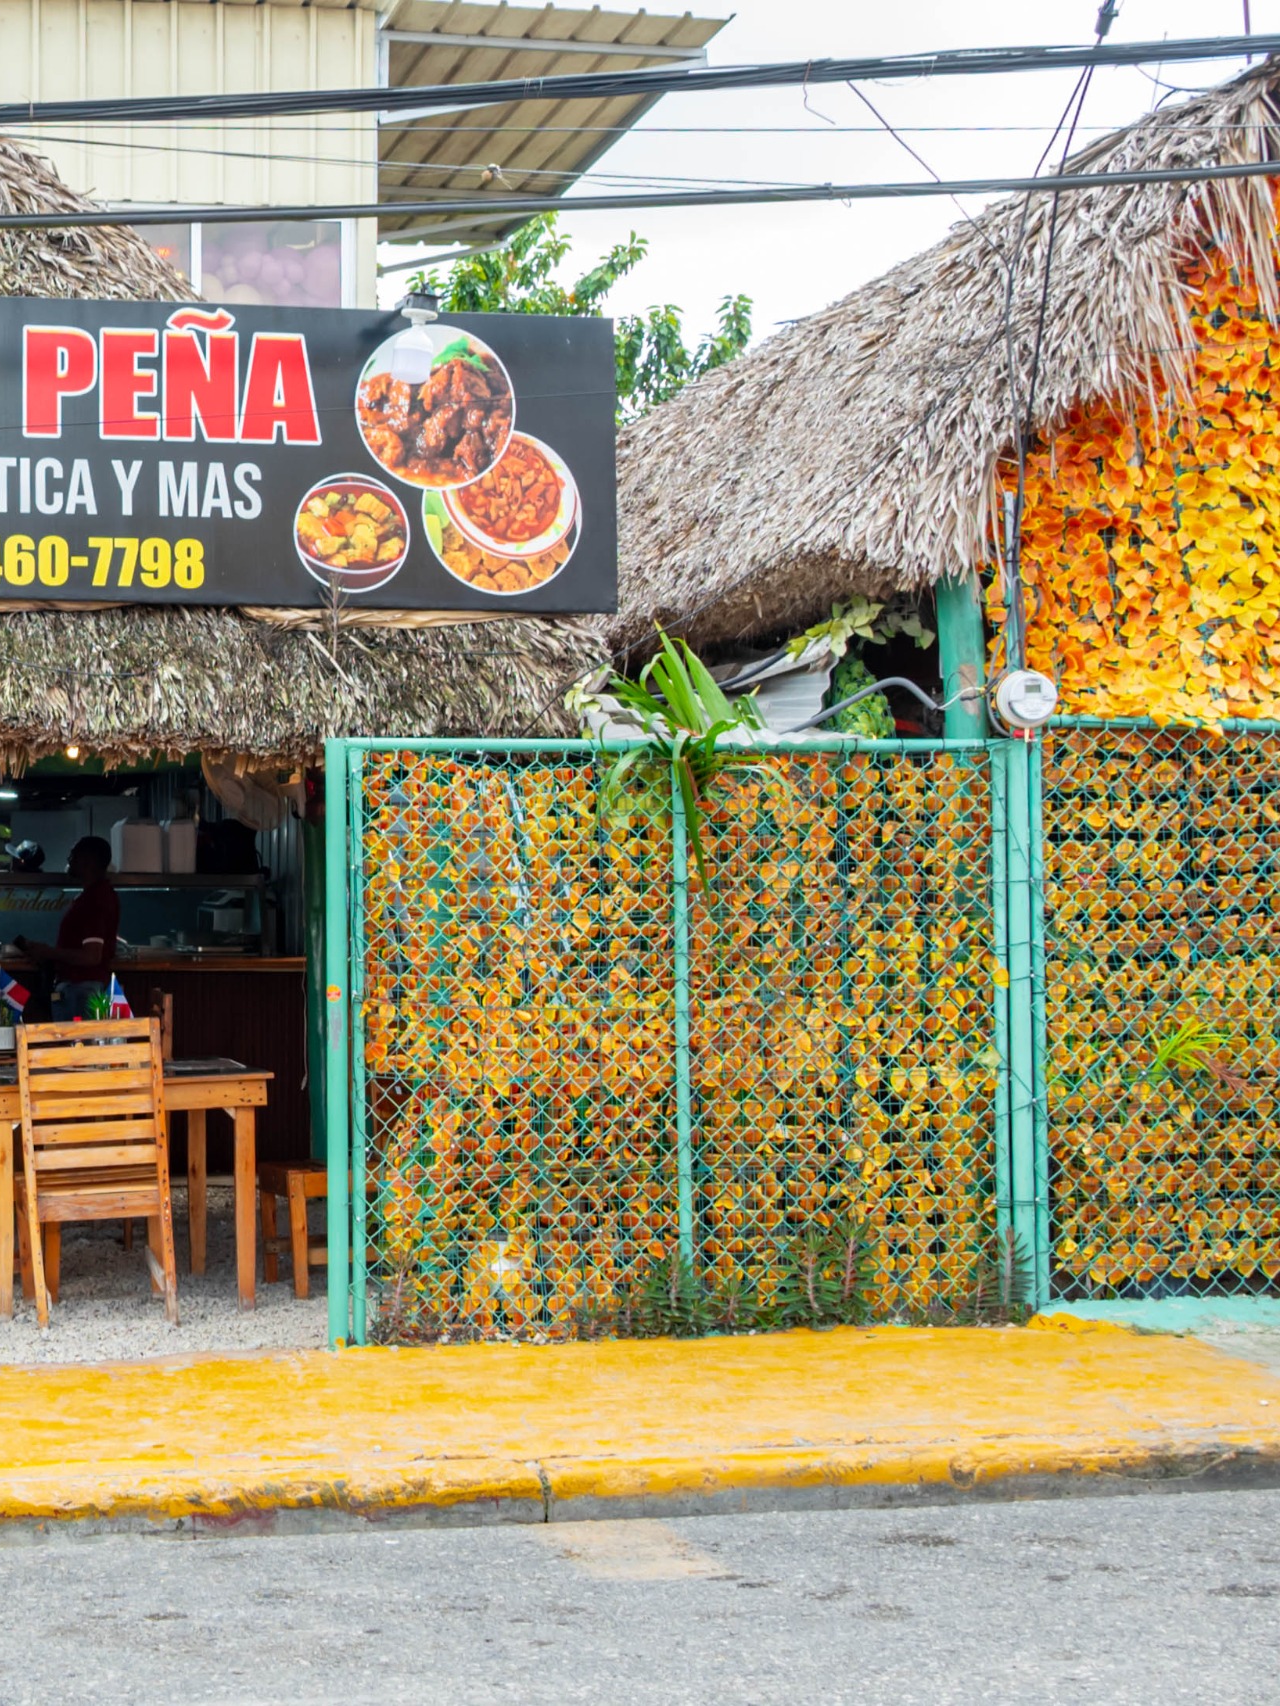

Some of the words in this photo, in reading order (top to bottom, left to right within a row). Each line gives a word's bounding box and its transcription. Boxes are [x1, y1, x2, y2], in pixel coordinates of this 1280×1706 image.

[22, 306, 323, 446] PEÑA
[110, 459, 143, 517] Y
[158, 460, 263, 520] MAS
